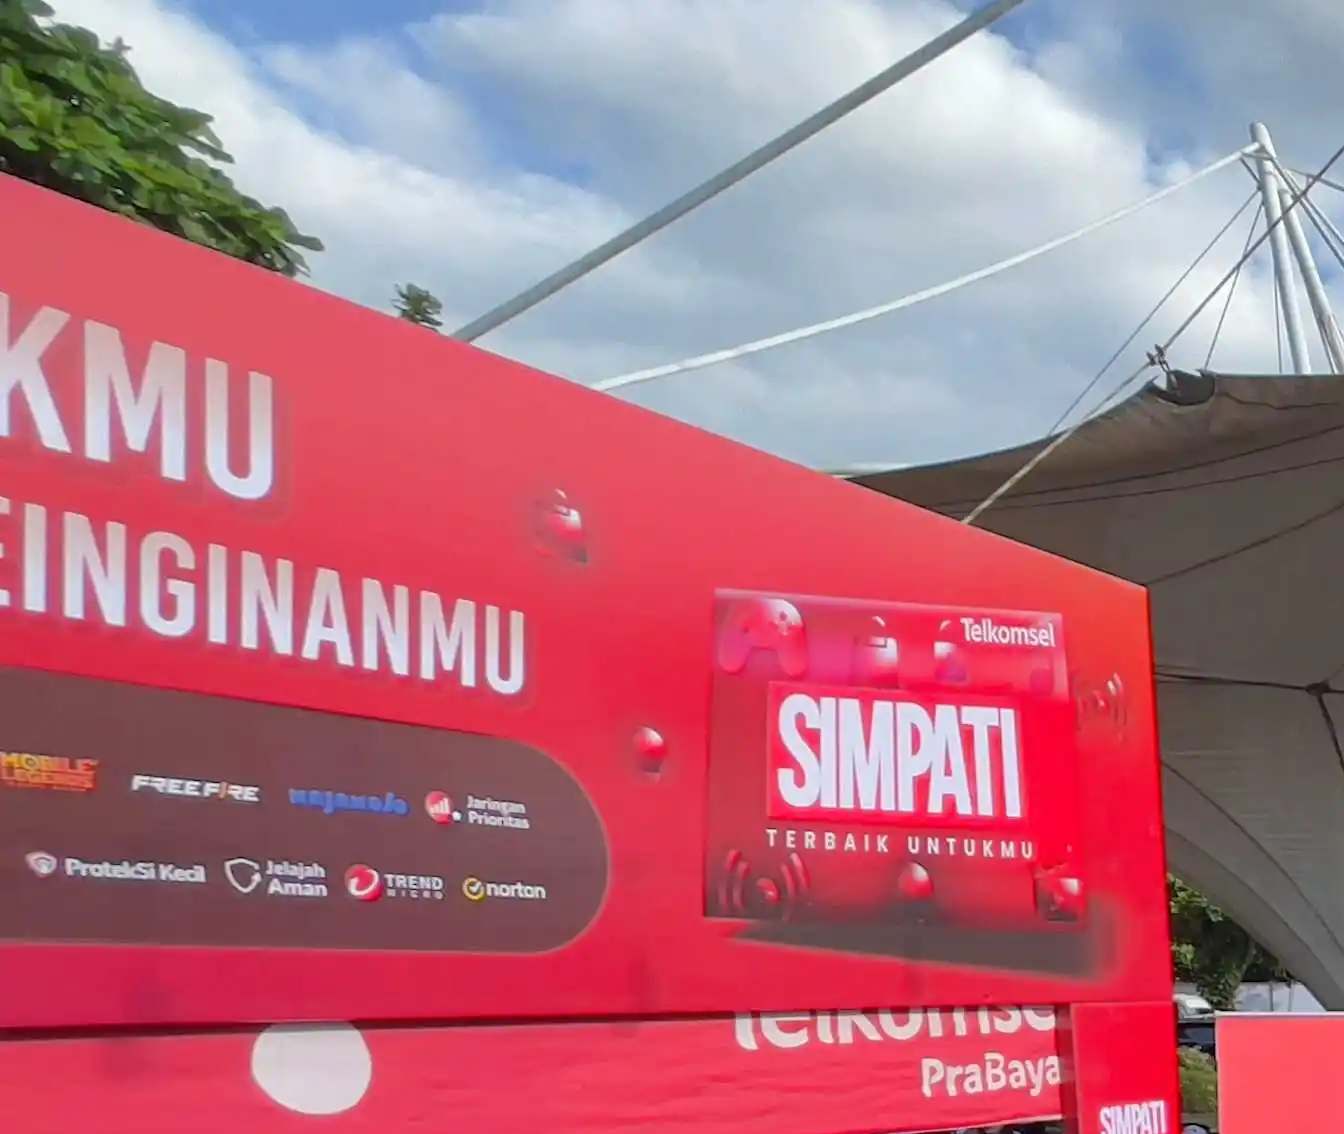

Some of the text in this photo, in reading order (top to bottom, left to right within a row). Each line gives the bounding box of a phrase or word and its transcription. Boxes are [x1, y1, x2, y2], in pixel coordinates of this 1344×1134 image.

[0, 291, 272, 500] KMU
[960, 616, 1056, 648] Telkomsel
[777, 693, 1022, 819] SIMPATI
[466, 794, 527, 816] Jaringan
[467, 810, 530, 830] Prioritas
[765, 828, 1034, 860] TERBAIK UNTUKMU
[159, 863, 206, 883] Kecil
[265, 859, 326, 880] Jelajah
[267, 877, 328, 897] Aman
[384, 872, 444, 891] TREND
[485, 881, 547, 900] norton
[733, 1006, 1056, 1050] Telkomse
[920, 1052, 1061, 1098] PraBaya
